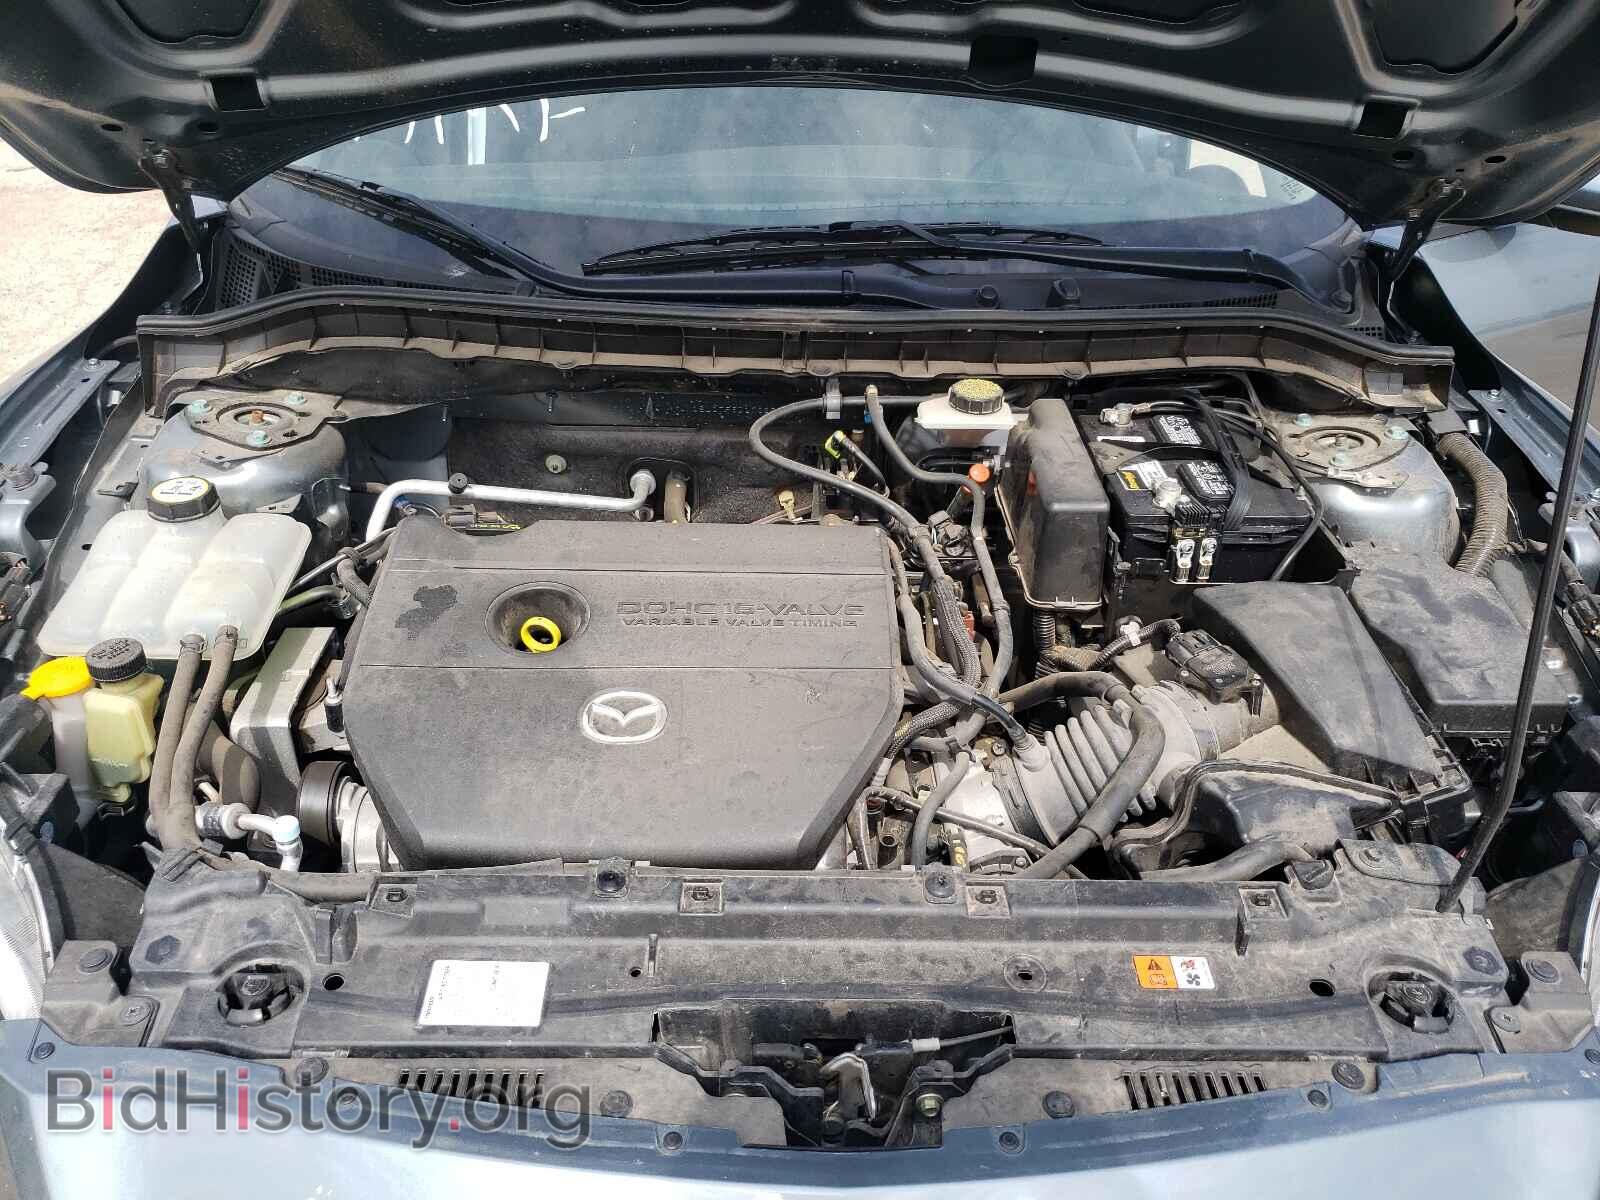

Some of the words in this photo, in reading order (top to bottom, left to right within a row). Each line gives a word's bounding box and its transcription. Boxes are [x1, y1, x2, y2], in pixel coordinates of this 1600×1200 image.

[615, 601, 719, 616] DOHC
[722, 601, 865, 616] 16-VALVE
[621, 617, 720, 627] VARIABLE
[725, 618, 786, 628] VALVE
[788, 619, 858, 628] TIMING
